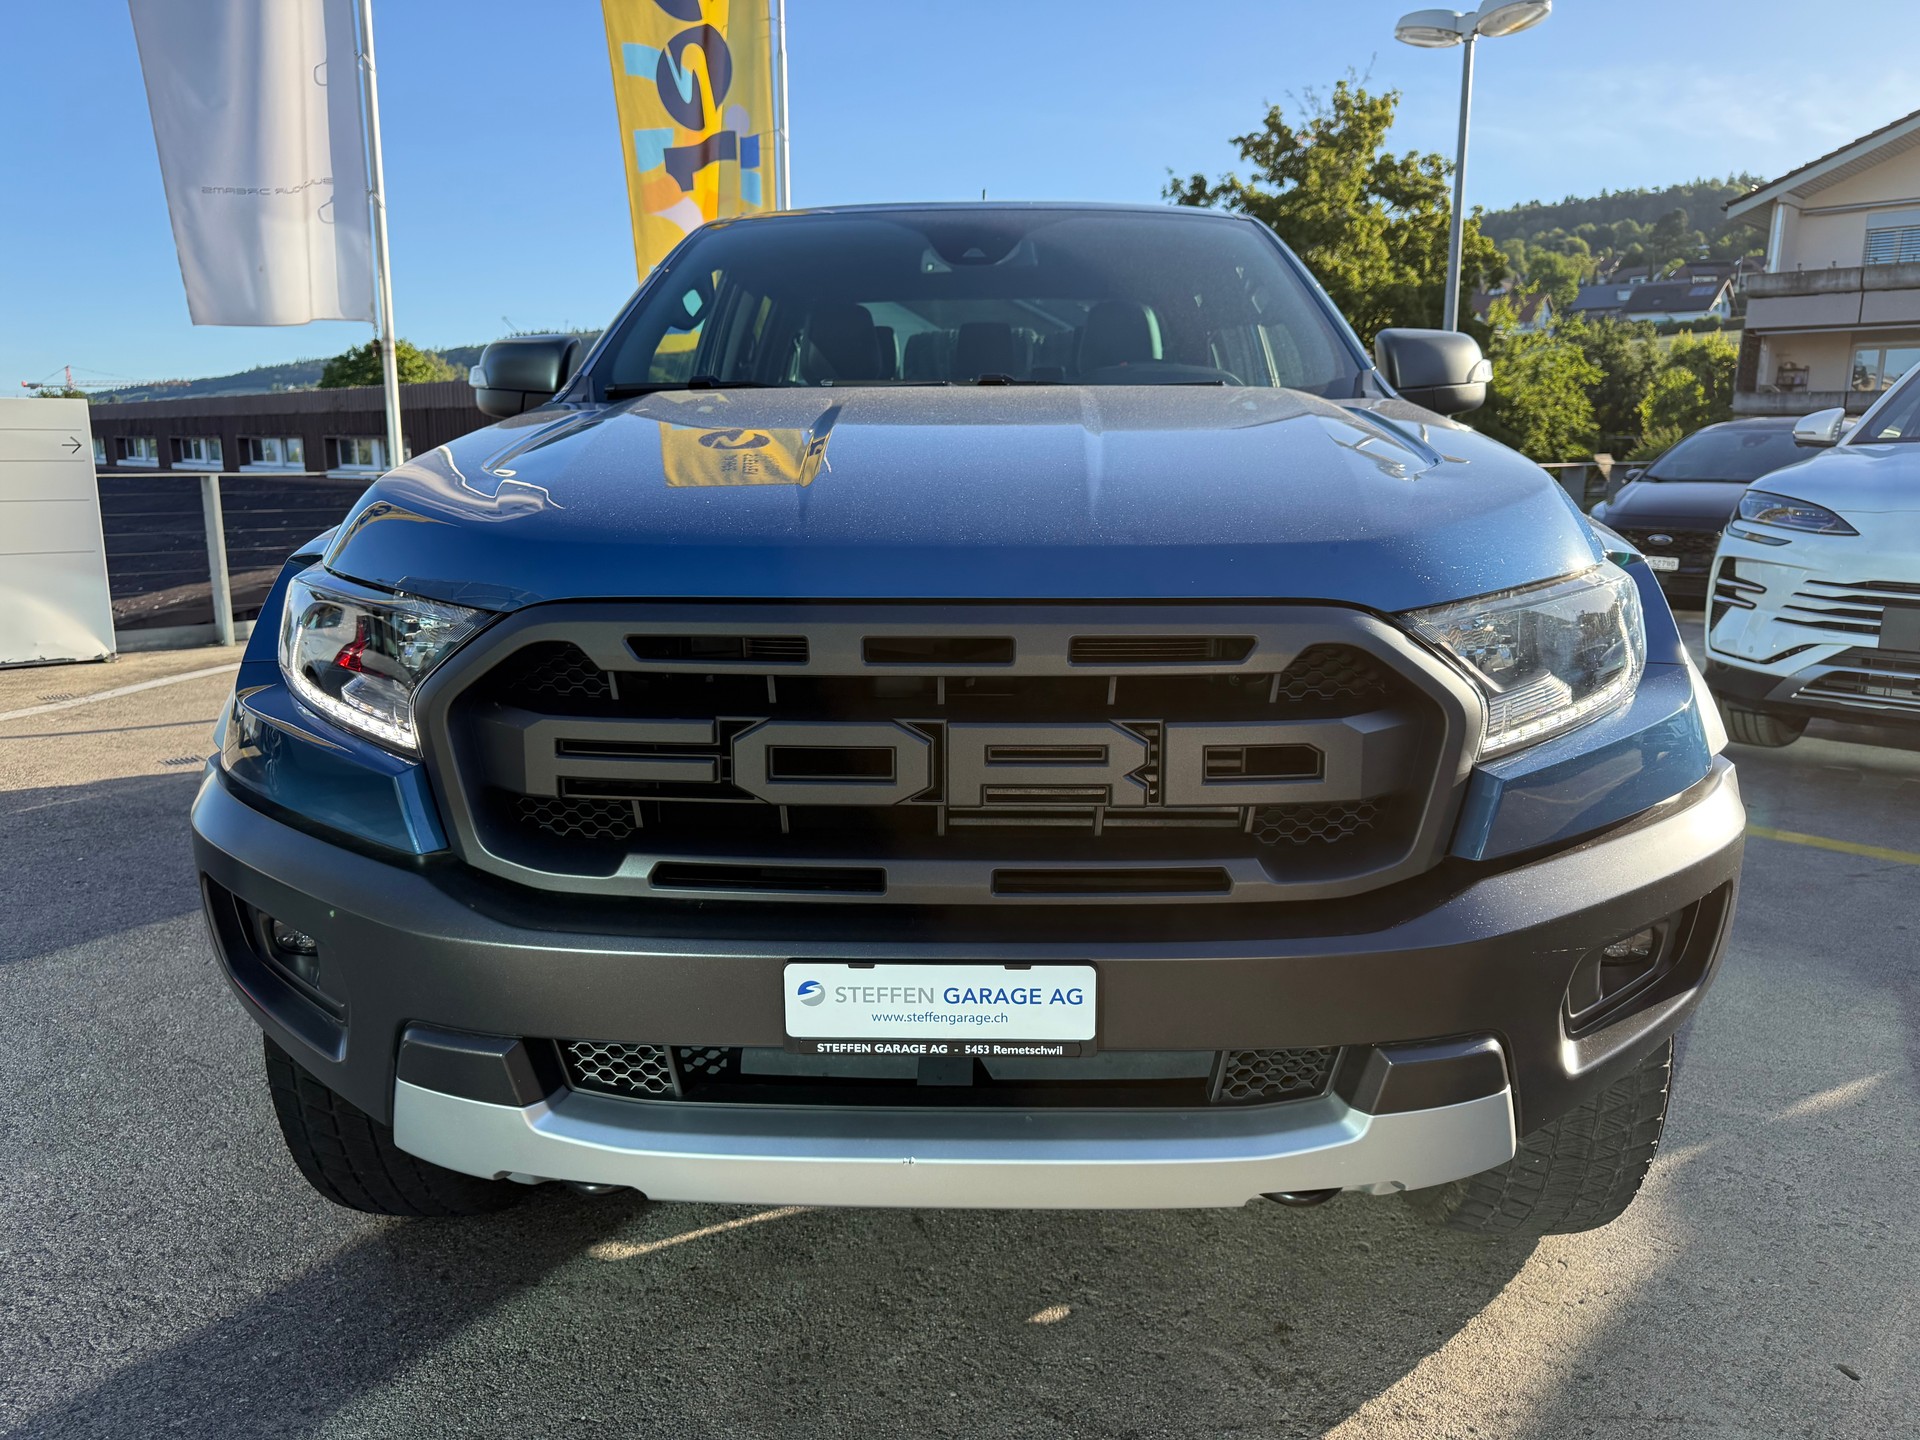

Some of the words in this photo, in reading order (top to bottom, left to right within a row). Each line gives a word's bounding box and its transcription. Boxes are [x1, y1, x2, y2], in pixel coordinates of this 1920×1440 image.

[523, 715, 1364, 807] FORD
[834, 986, 935, 1004] STEFFEN
[943, 987, 1042, 1005] GARAGE
[1048, 988, 1083, 1005] AG
[871, 1011, 1009, 1026] www.steffengarage.ch
[817, 1043, 871, 1053] STEFFEN
[874, 1044, 927, 1054] GARAGE
[929, 1045, 948, 1054] AG
[964, 1045, 990, 1055] 5453
[993, 1045, 1063, 1055] Remetschwil
